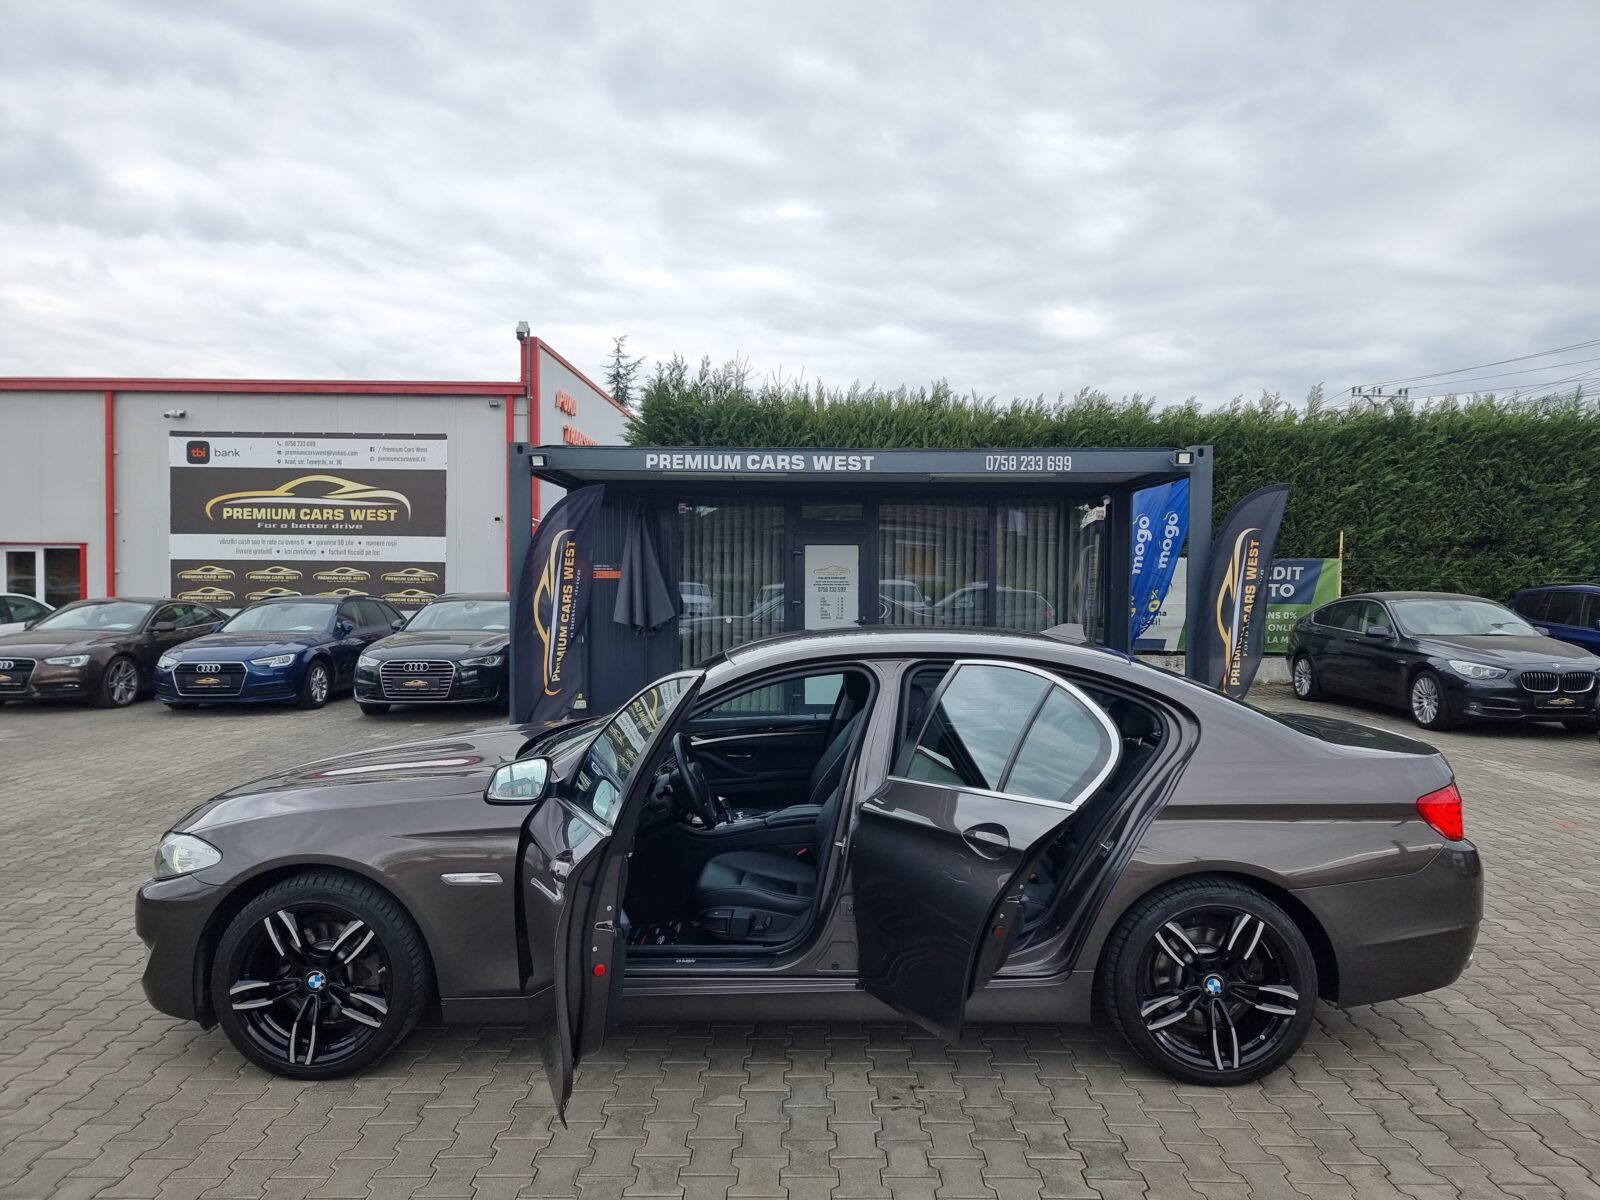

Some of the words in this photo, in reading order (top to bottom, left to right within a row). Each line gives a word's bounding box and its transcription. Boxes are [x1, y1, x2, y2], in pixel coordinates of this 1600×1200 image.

[190, 448, 206, 457] tbi
[214, 448, 240, 458] bank
[646, 454, 742, 469] PREMIUM
[746, 454, 805, 470] CARS
[812, 456, 874, 470] WEST
[986, 456, 1016, 470] 0758
[1020, 456, 1042, 470] 233
[1047, 456, 1072, 471] 699
[222, 508, 296, 520] PREMIUM
[300, 508, 344, 520] CARS
[350, 509, 398, 522] WEST
[564, 540, 576, 580] WEST
[1132, 516, 1152, 574] mogo
[1158, 513, 1180, 569] mogo
[1246, 540, 1260, 580] WEST
[561, 584, 573, 622] CARS
[1243, 584, 1256, 622] CARS
[1266, 612, 1281, 620] NS
[1283, 612, 1297, 620] 0%
